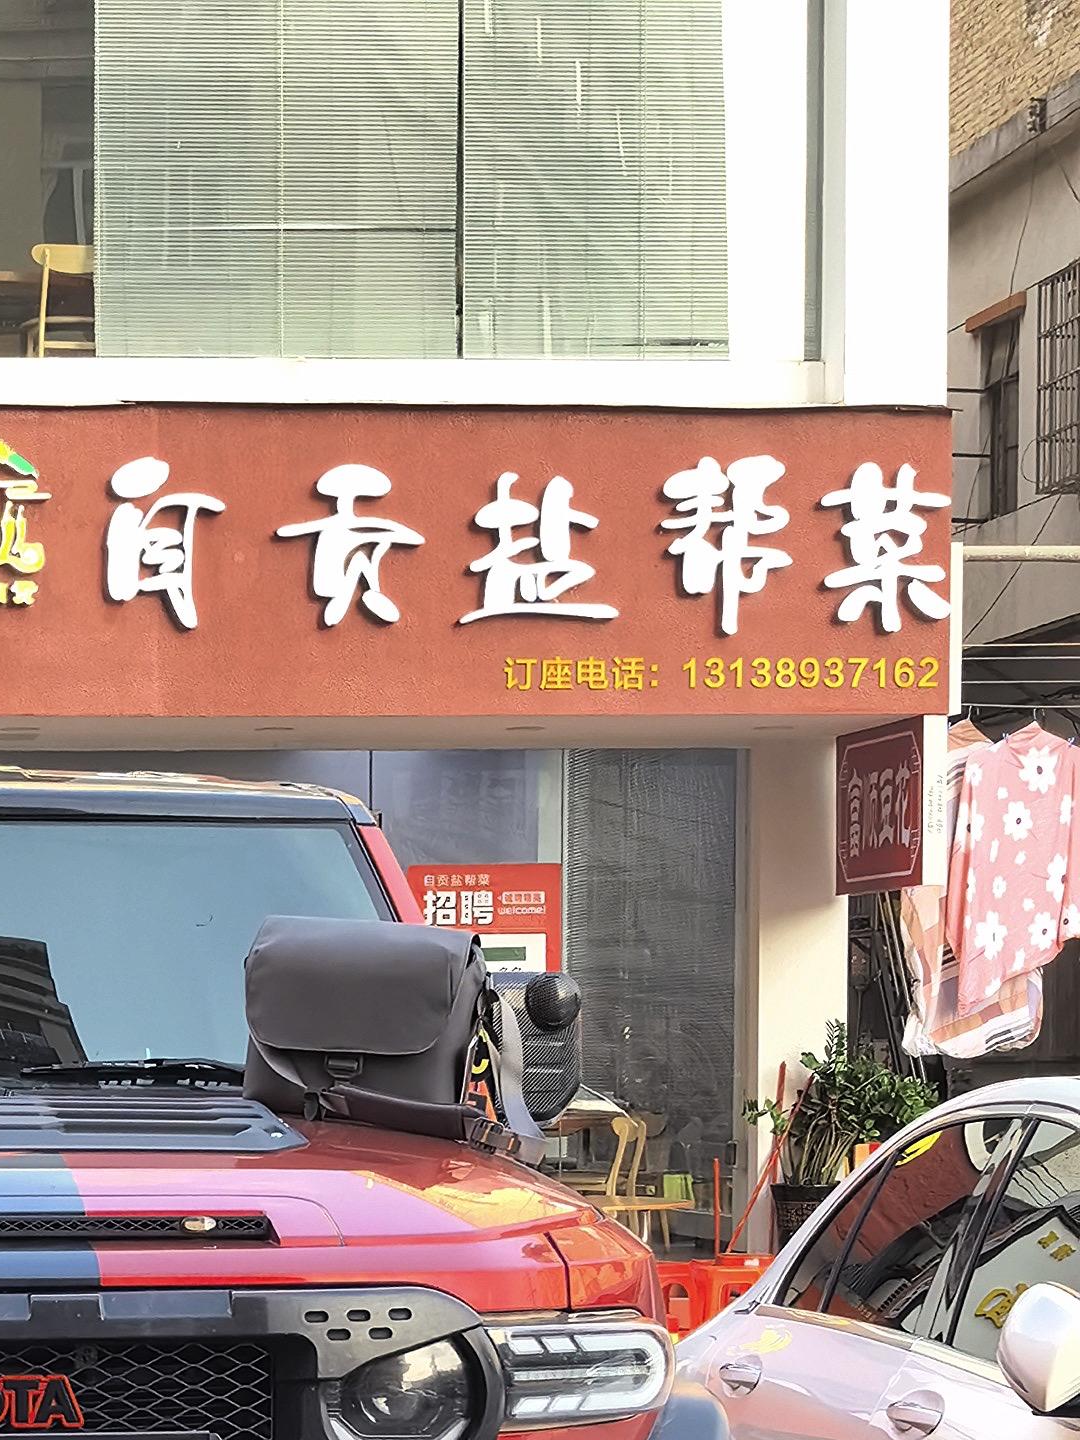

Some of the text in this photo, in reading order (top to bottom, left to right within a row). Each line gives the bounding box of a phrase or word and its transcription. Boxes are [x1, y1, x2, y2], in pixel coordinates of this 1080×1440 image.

[105, 454, 952, 635] 自贡盐帮菜
[423, 890, 494, 926] 招聘
